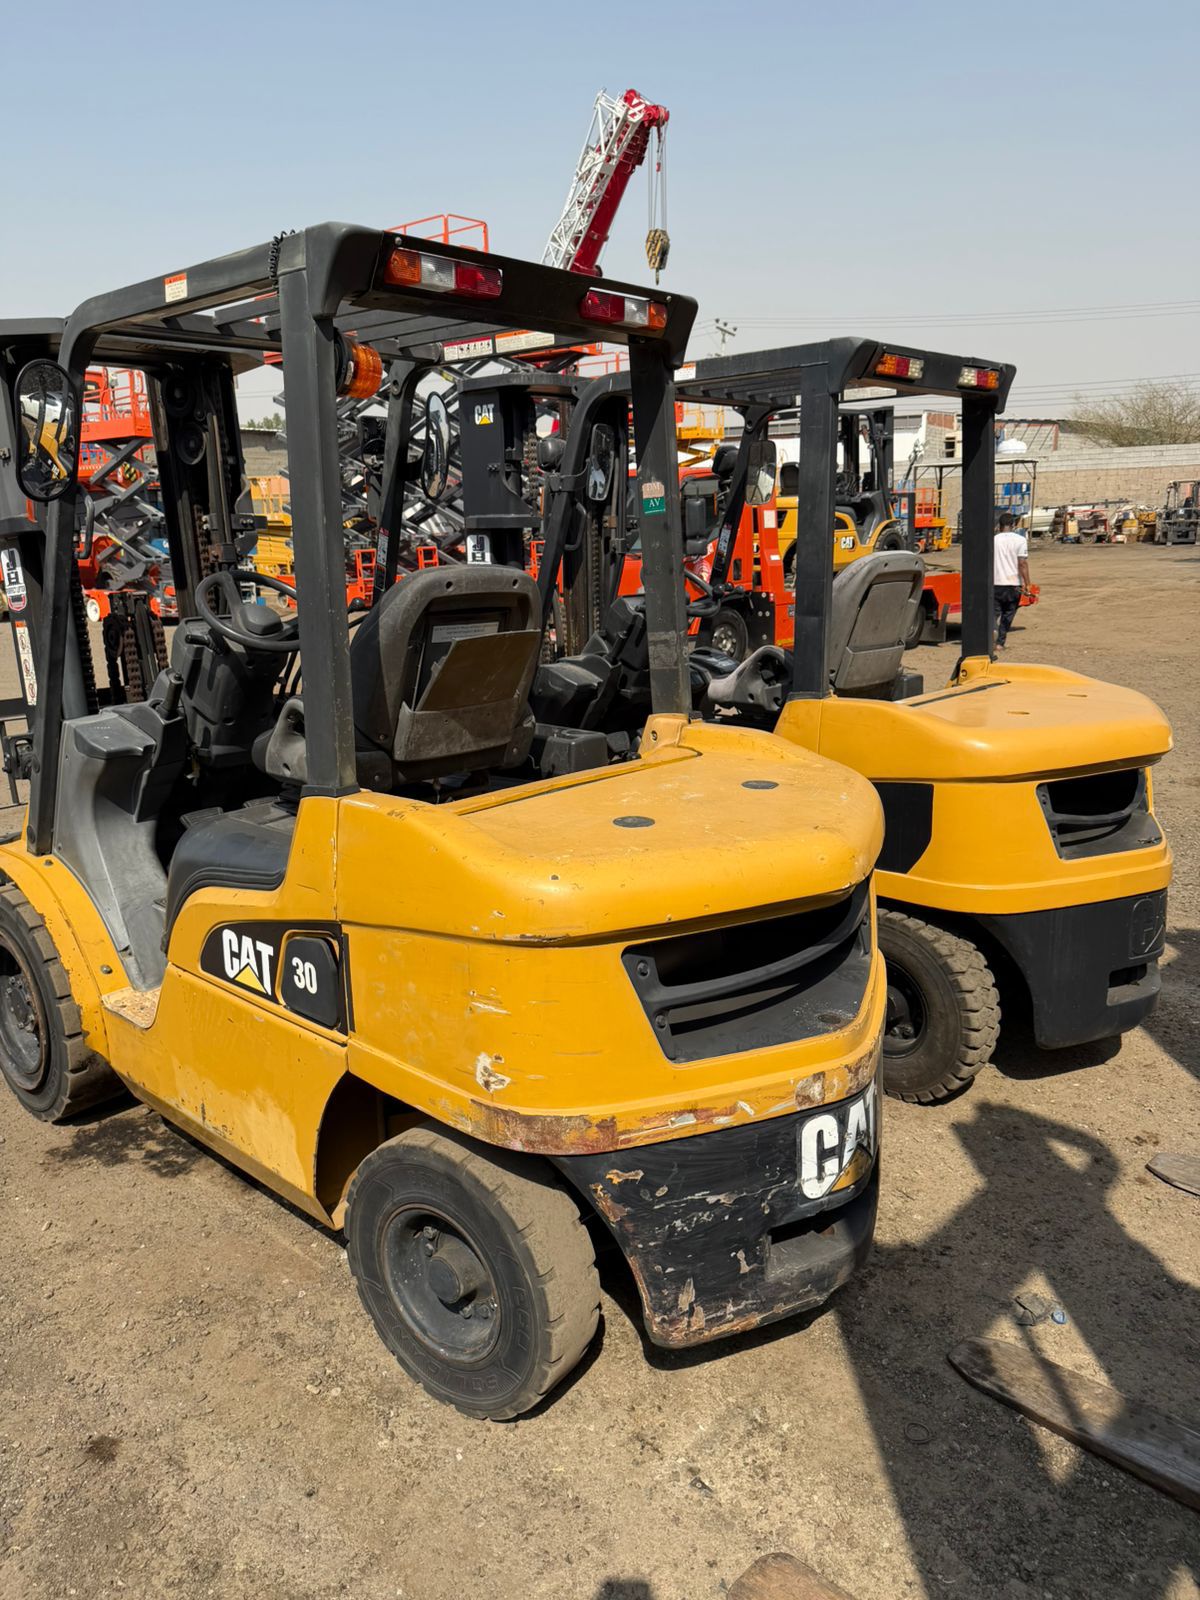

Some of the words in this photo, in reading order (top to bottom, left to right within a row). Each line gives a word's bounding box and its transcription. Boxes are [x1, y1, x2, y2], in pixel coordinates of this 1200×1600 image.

[474, 403, 495, 425] CAT
[649, 498, 661, 508] AV
[840, 536, 854, 549] CAT
[222, 928, 274, 996] CAT
[291, 956, 318, 995] 30
